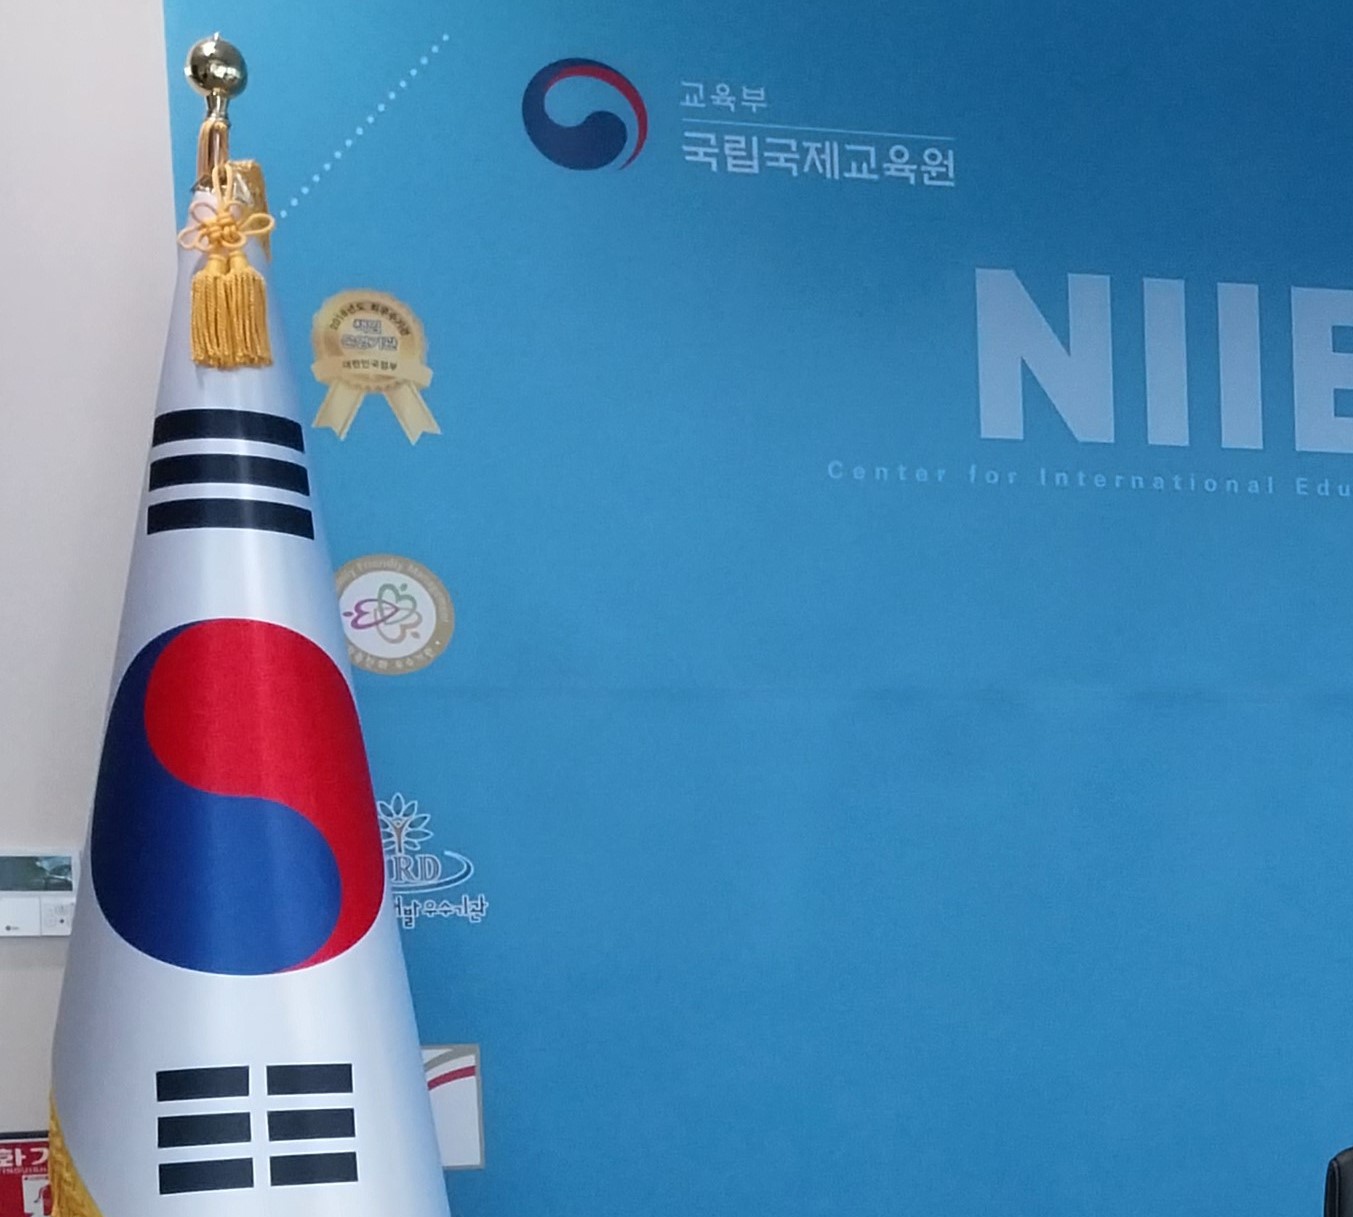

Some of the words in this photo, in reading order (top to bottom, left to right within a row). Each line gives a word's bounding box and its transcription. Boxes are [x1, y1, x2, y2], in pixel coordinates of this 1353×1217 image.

[681, 80, 768, 113] 교육부
[682, 131, 955, 187] 국립국제교육원
[827, 460, 947, 483] Center
[968, 464, 1018, 485] for
[1039, 467, 1275, 495] International
